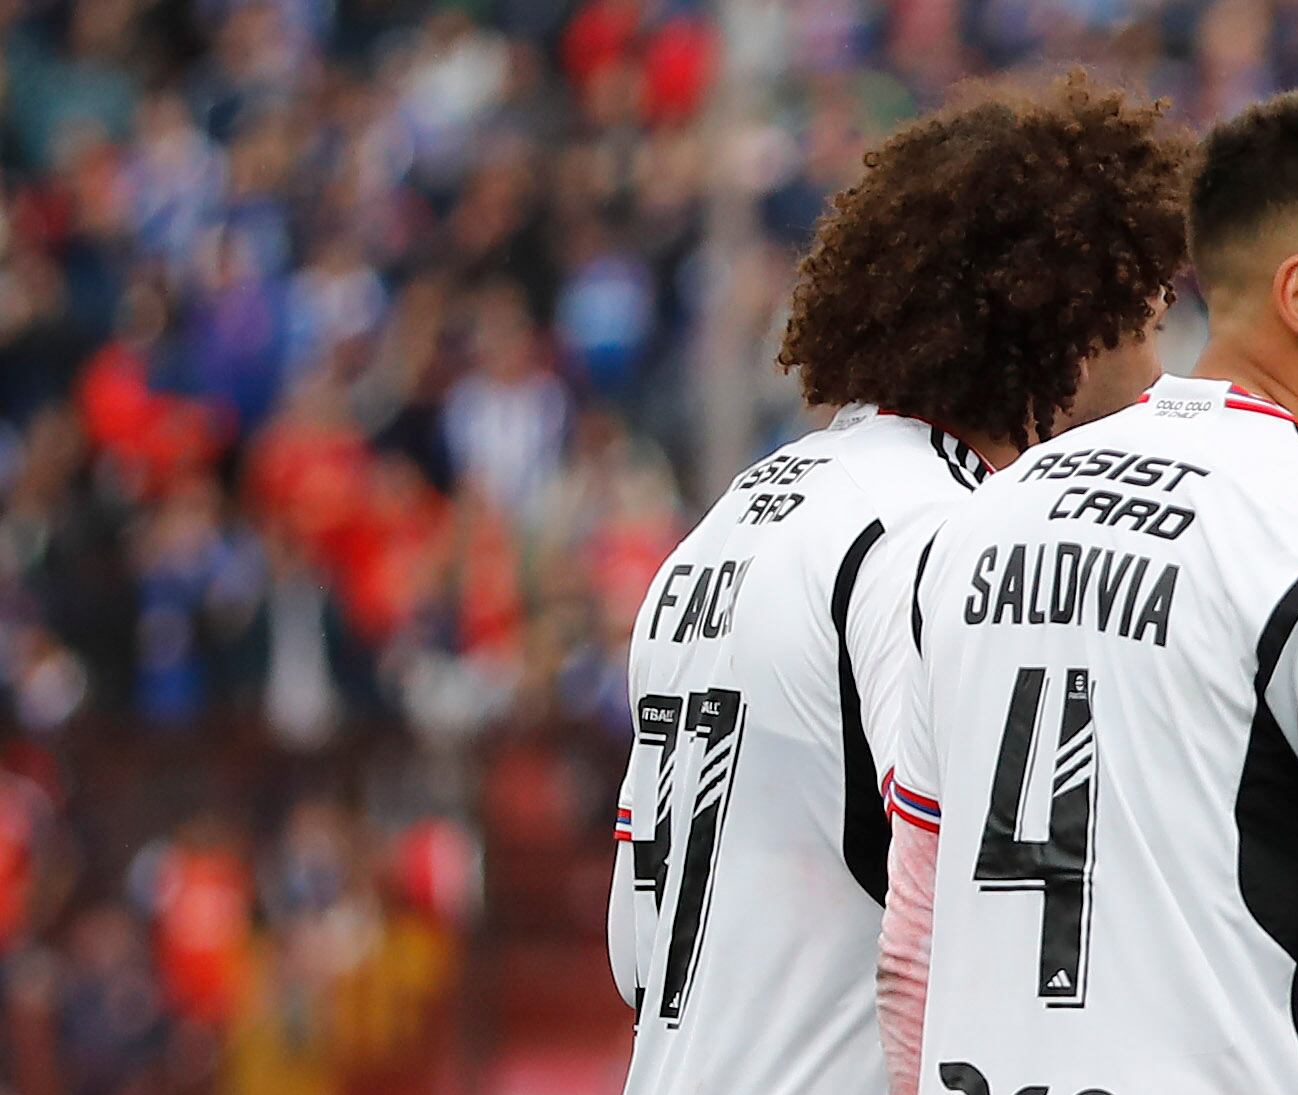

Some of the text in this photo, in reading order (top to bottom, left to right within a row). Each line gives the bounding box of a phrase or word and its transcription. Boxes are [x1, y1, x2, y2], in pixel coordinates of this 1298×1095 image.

[1156, 400, 1212, 411] COLO COLO
[733, 455, 832, 491] SSIST
[1018, 448, 1211, 492] ASSIST
[739, 493, 805, 525] ARD
[1048, 487, 1196, 541] CARD
[964, 541, 1180, 648] SALDIVIA
[973, 667, 1096, 1008] 4
